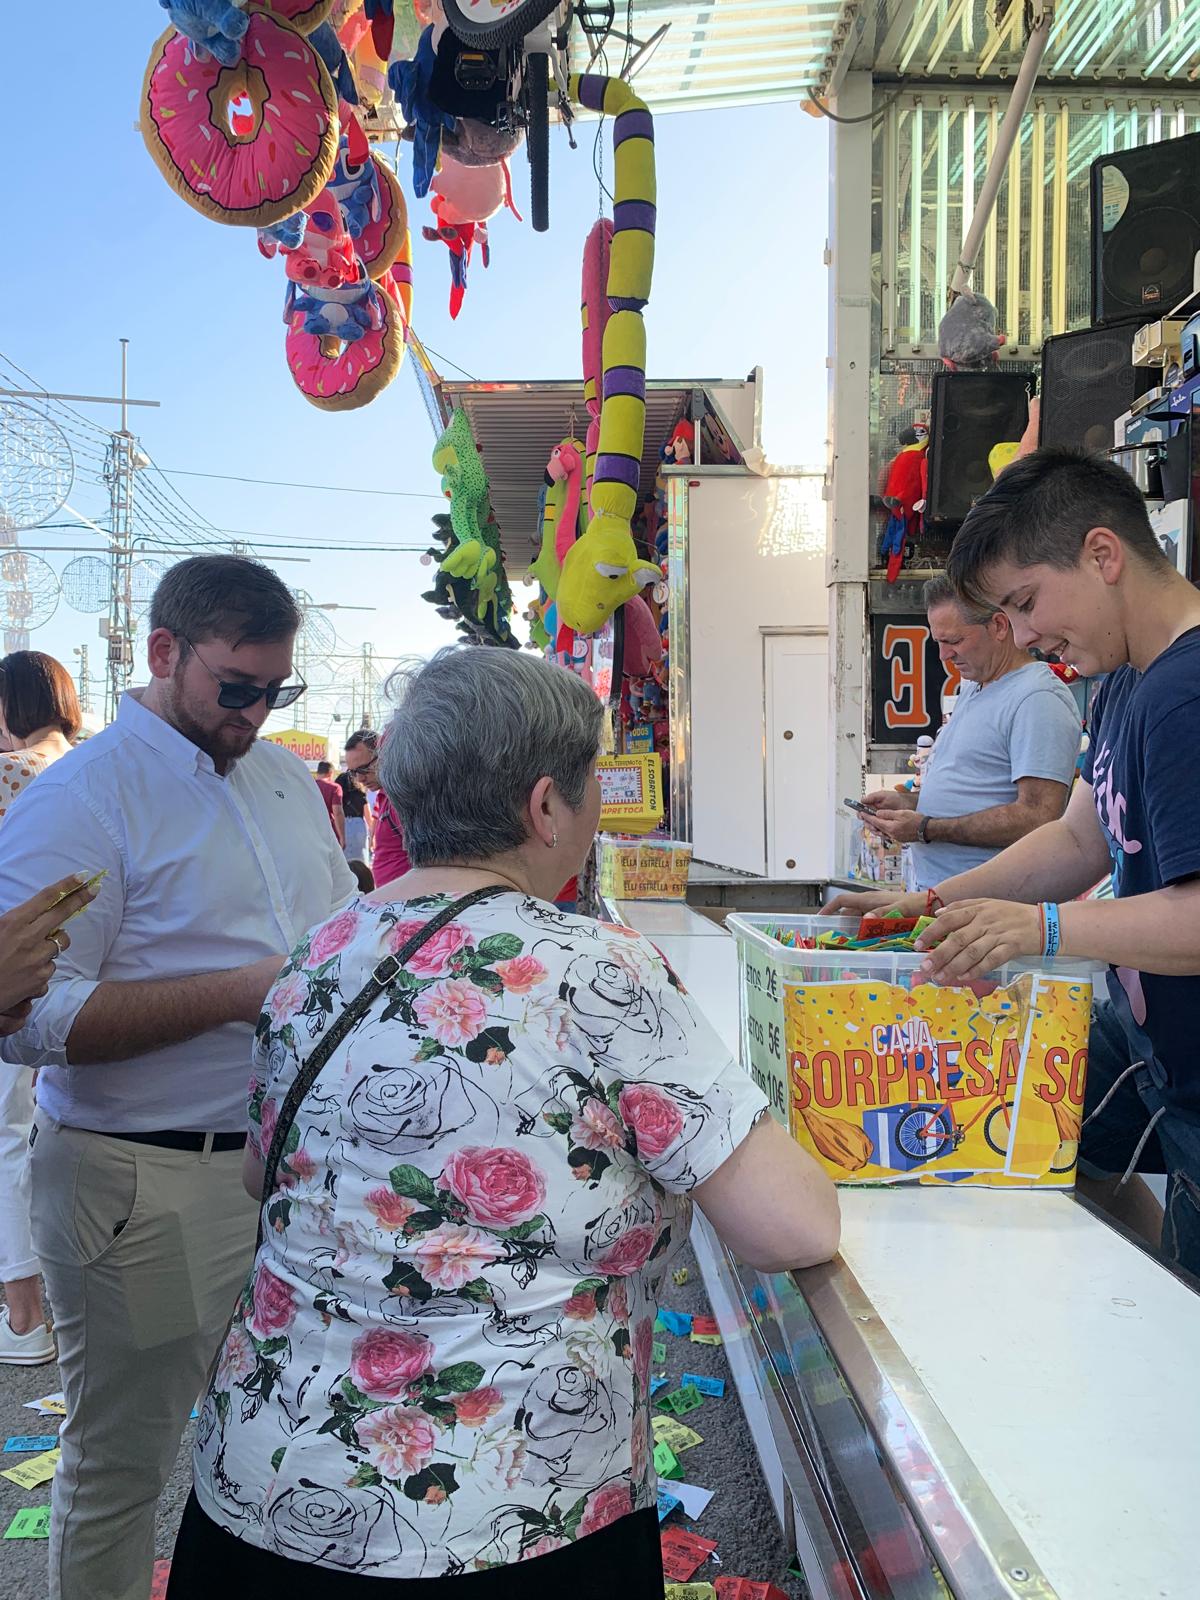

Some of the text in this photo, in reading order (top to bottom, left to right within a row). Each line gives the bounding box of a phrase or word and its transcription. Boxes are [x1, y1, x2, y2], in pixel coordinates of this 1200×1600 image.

[768, 1022, 781, 1060] 5€
[871, 1020, 936, 1056] CAJA
[767, 1070, 786, 1115] 10€
[791, 1039, 1021, 1109] SORPRESA
